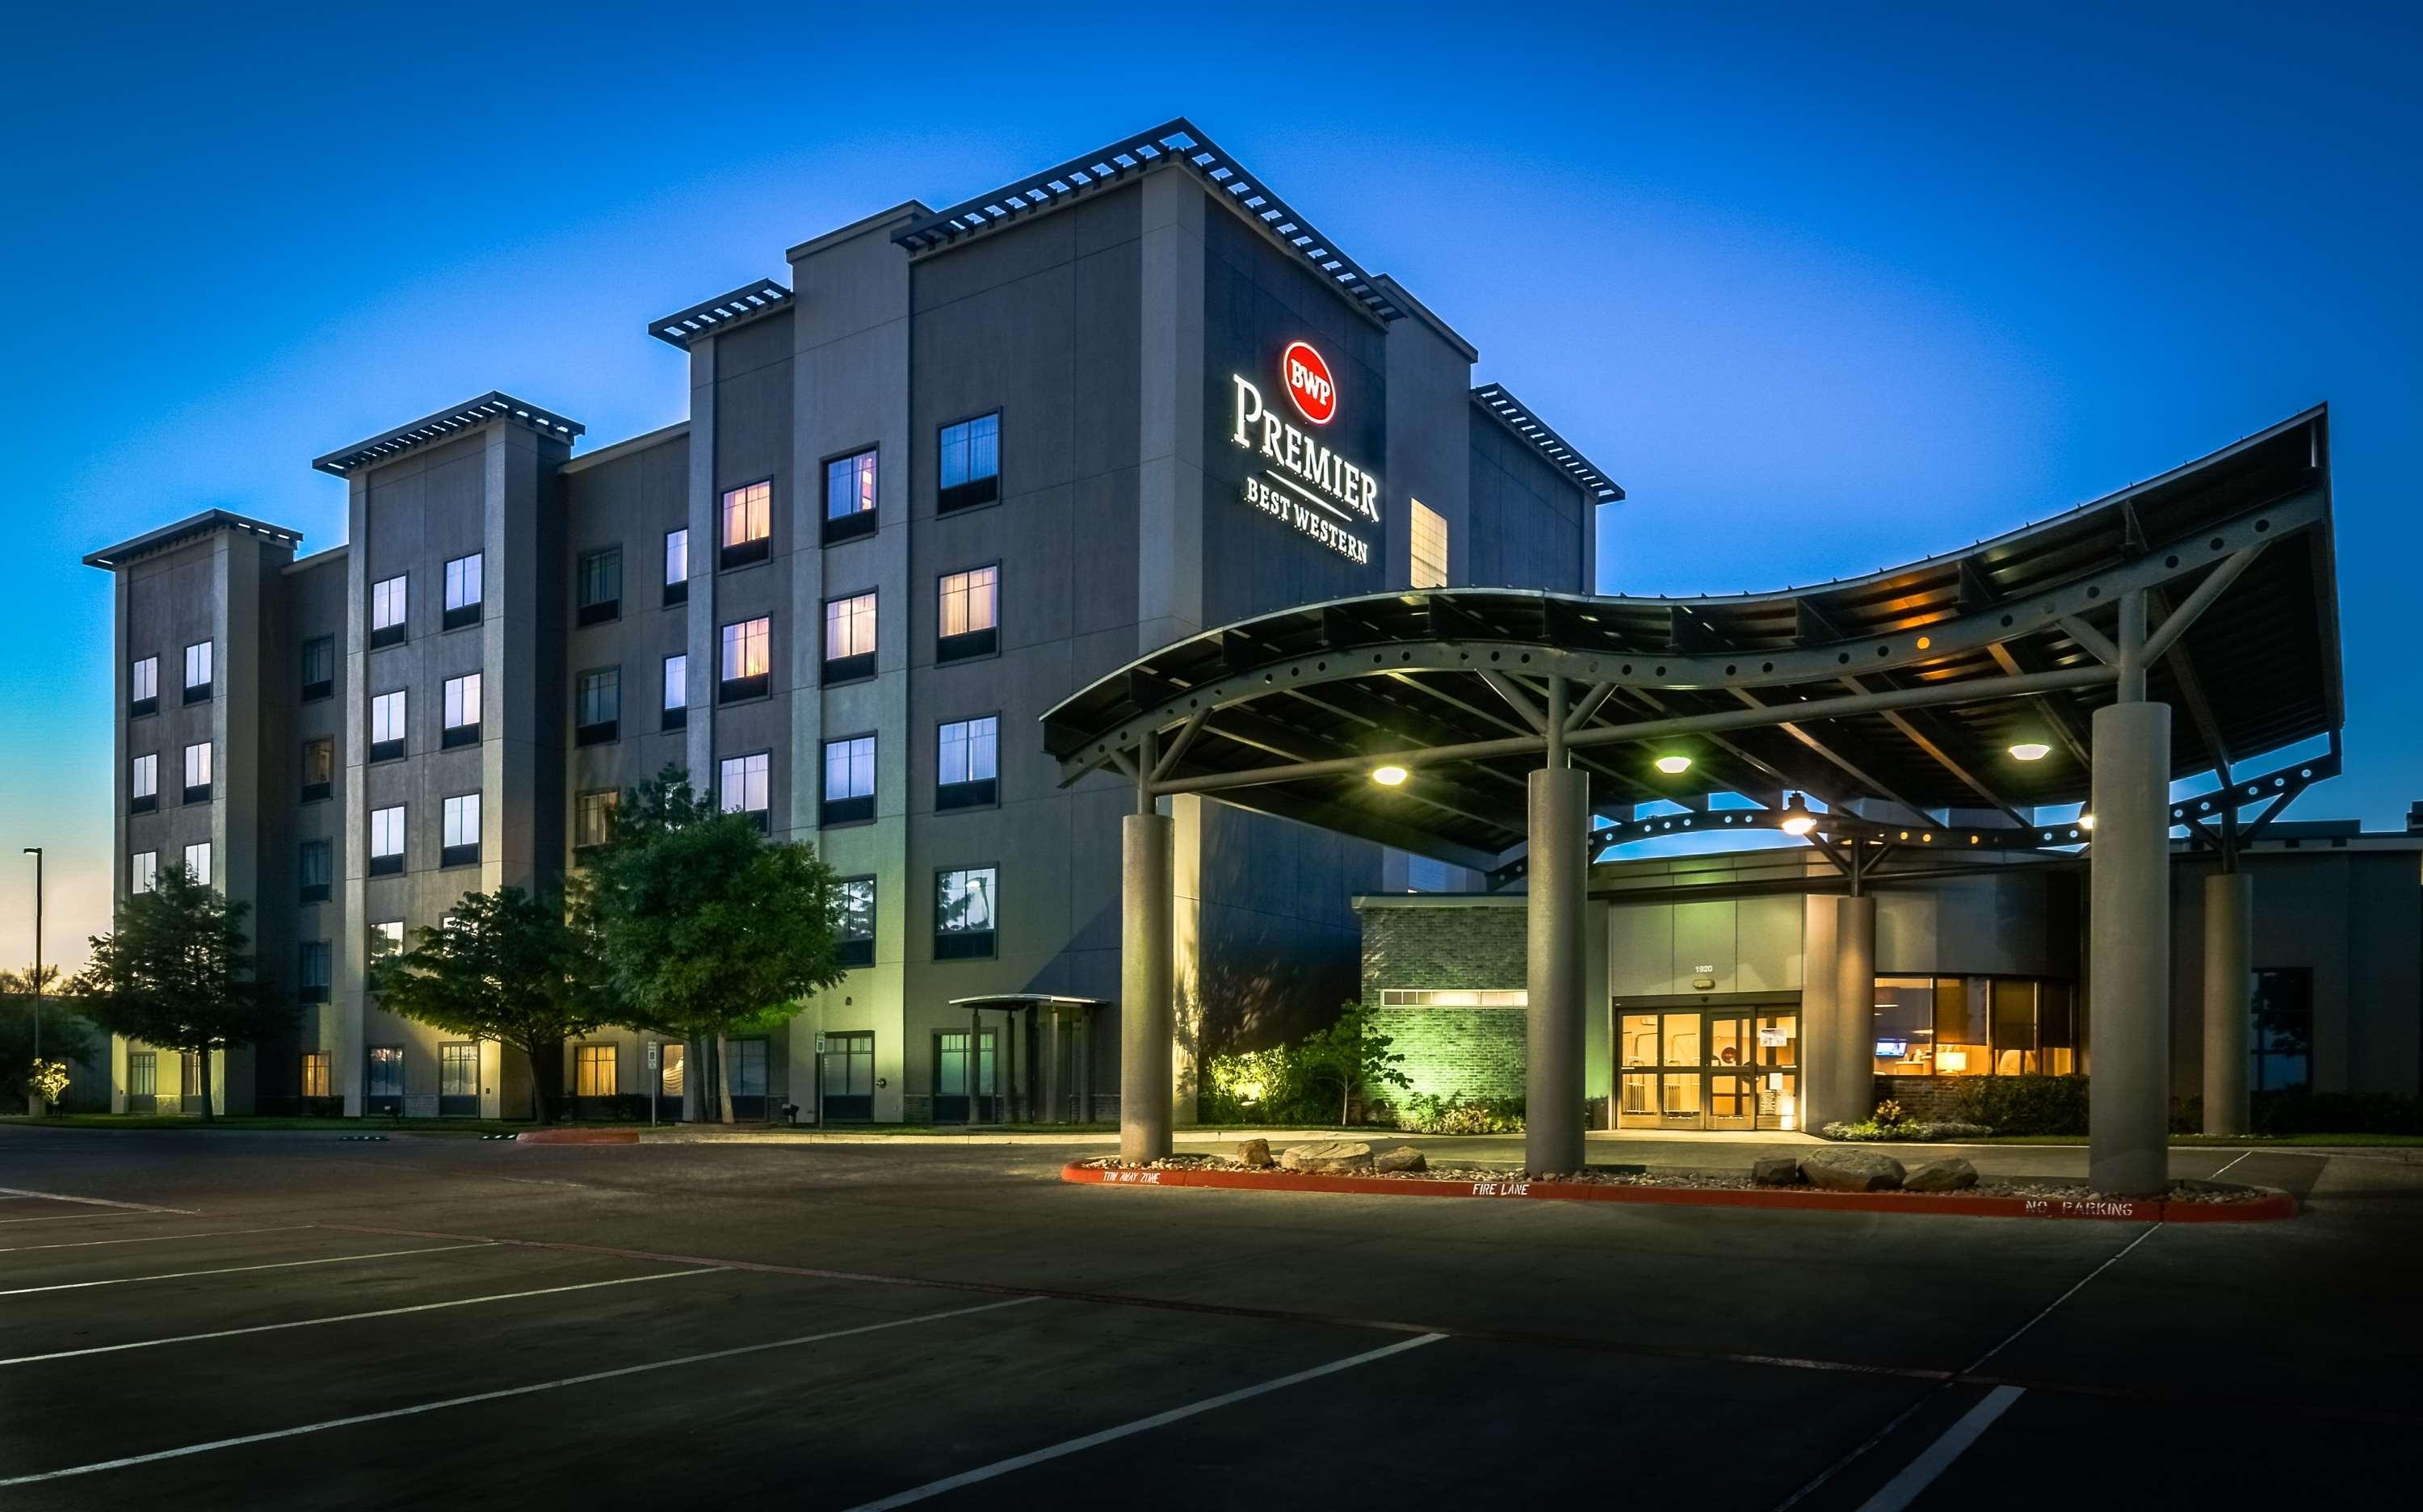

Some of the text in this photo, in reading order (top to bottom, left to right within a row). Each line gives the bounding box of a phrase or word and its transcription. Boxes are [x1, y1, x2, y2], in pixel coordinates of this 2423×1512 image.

[1291, 359, 1330, 405] BWP
[1233, 374, 1379, 522] PREMIER
[1247, 477, 1367, 563] BEST WESTERN
[1694, 965, 1712, 973] 1920
[1140, 1172, 1161, 1184] ZONE
[1472, 1183, 1530, 1195] FIRE LANE
[2026, 1200, 2133, 1216] NO PARKING
